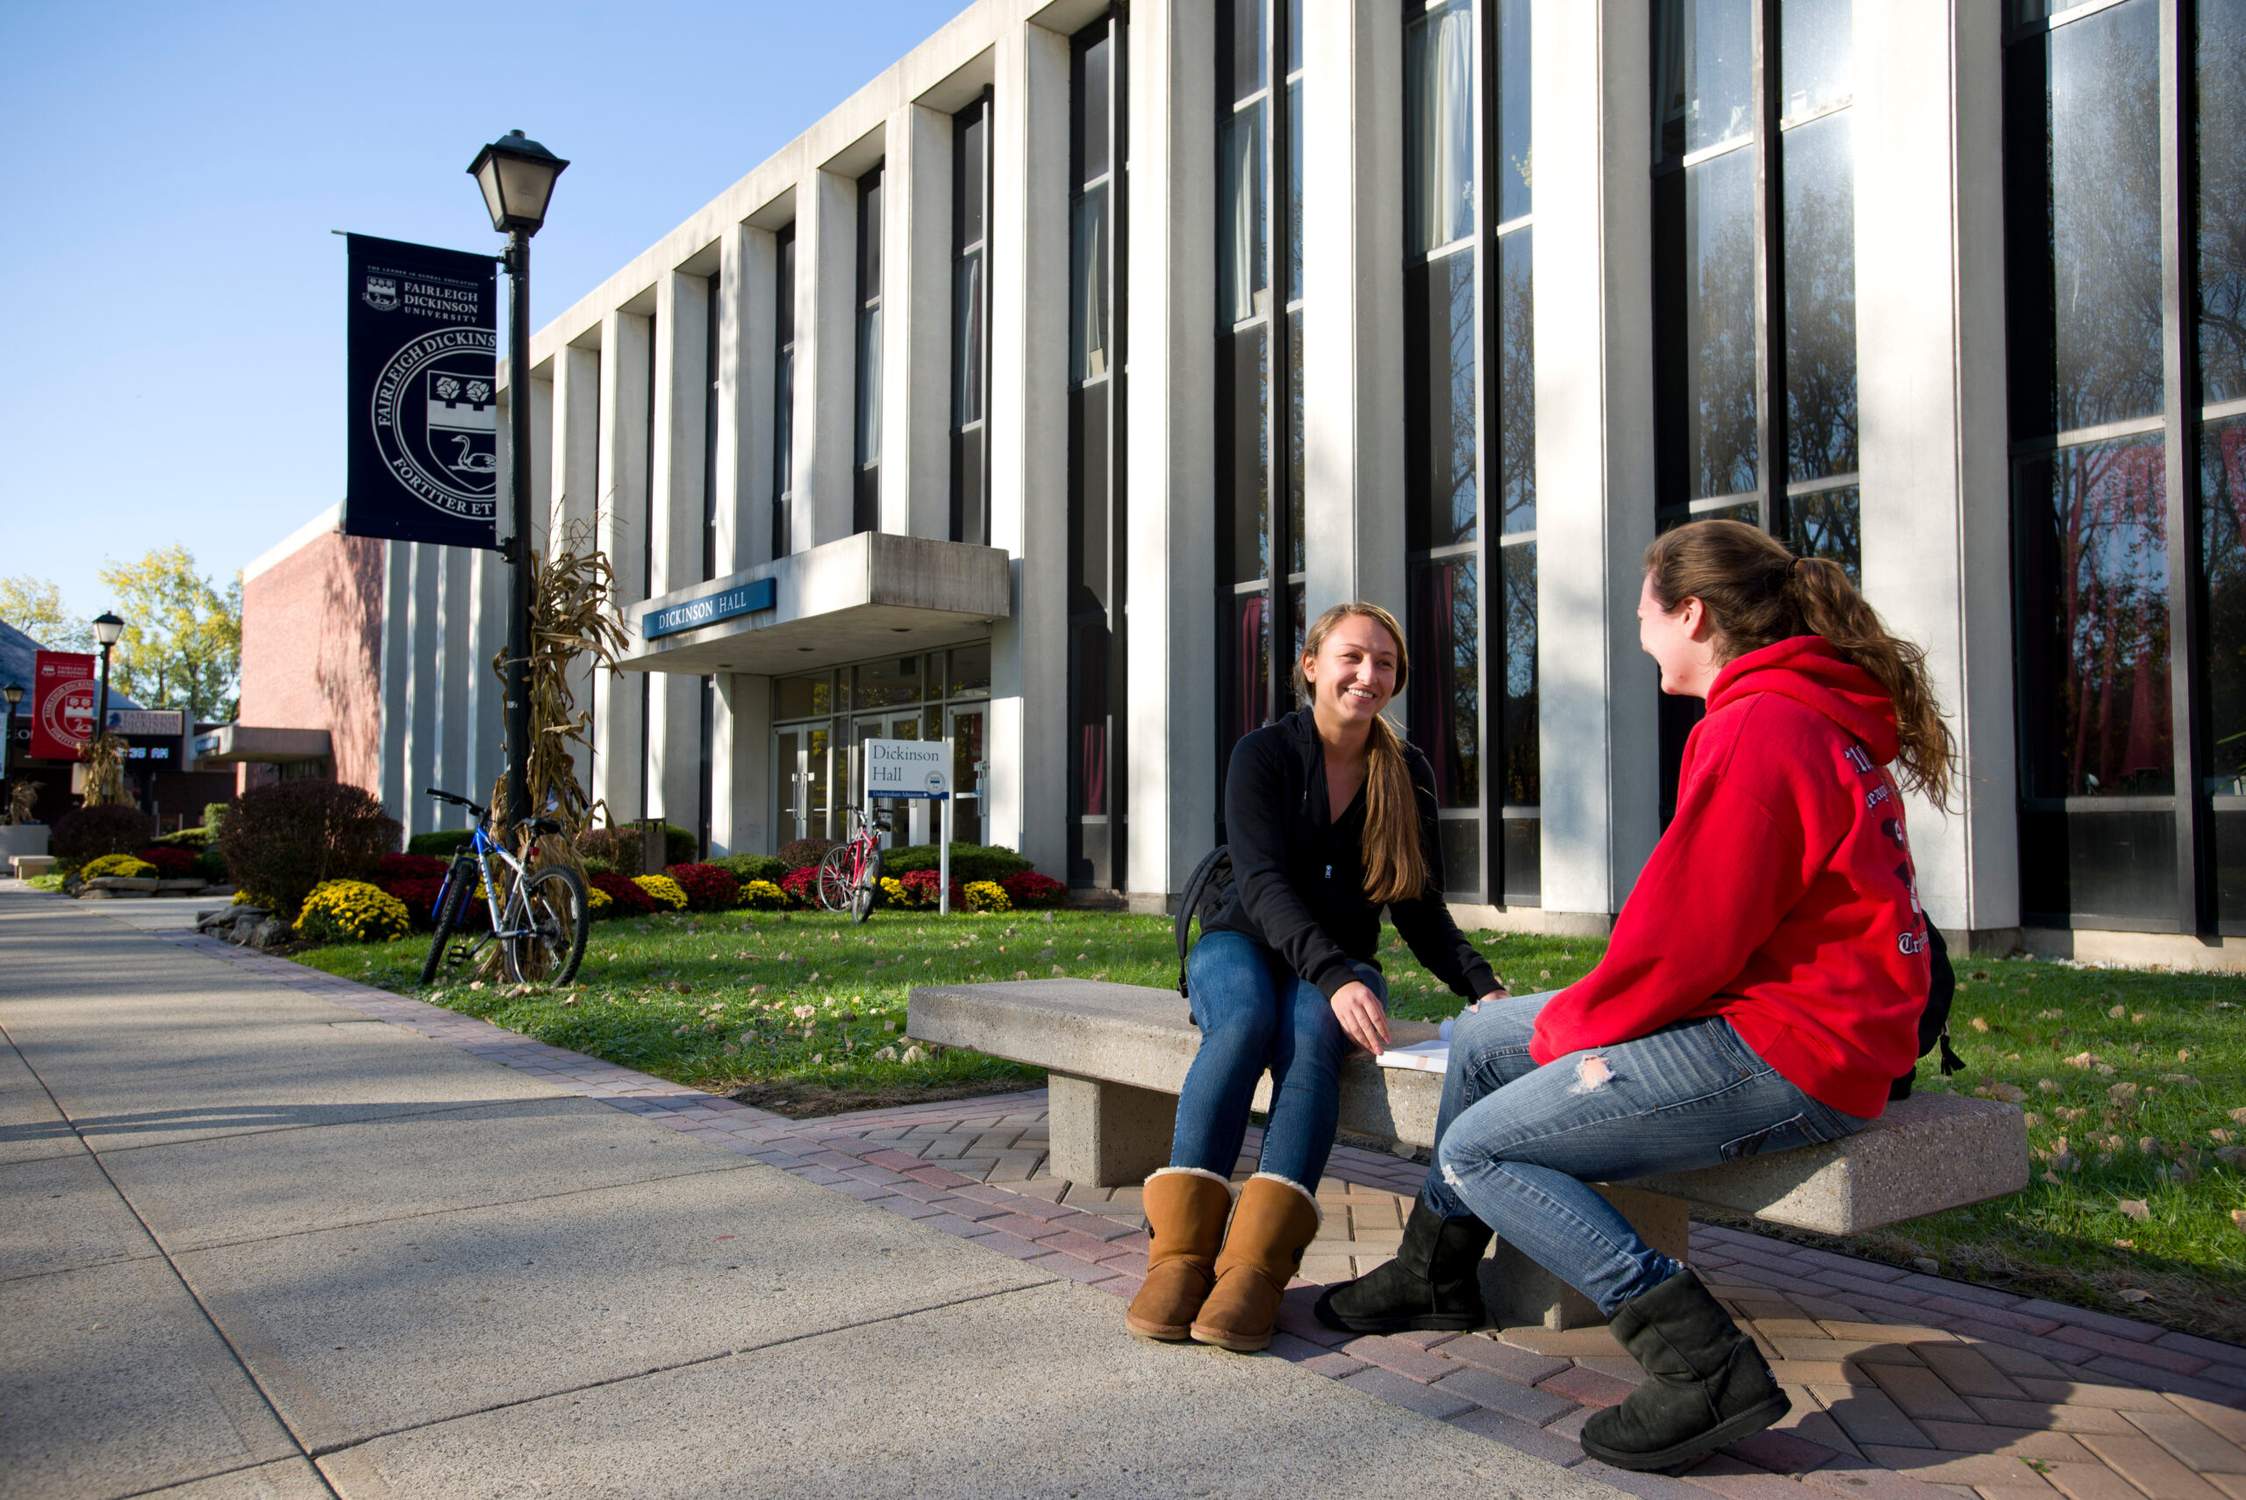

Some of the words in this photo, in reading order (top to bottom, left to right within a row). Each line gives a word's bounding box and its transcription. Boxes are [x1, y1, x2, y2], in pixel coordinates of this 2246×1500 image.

[404, 281, 478, 302] FAIRLEIGH
[404, 294, 478, 313] DICKINSON
[404, 306, 477, 323] UNIVERSITY
[377, 346, 425, 427] FAIRLEIGH
[422, 331, 496, 353] DICKINS
[393, 457, 466, 513] FORTITER
[471, 503, 492, 516] ET
[658, 600, 713, 630] DICKINSON
[719, 591, 747, 613] HALL
[873, 744, 939, 761] Dickinson
[873, 766, 902, 782] Hall
